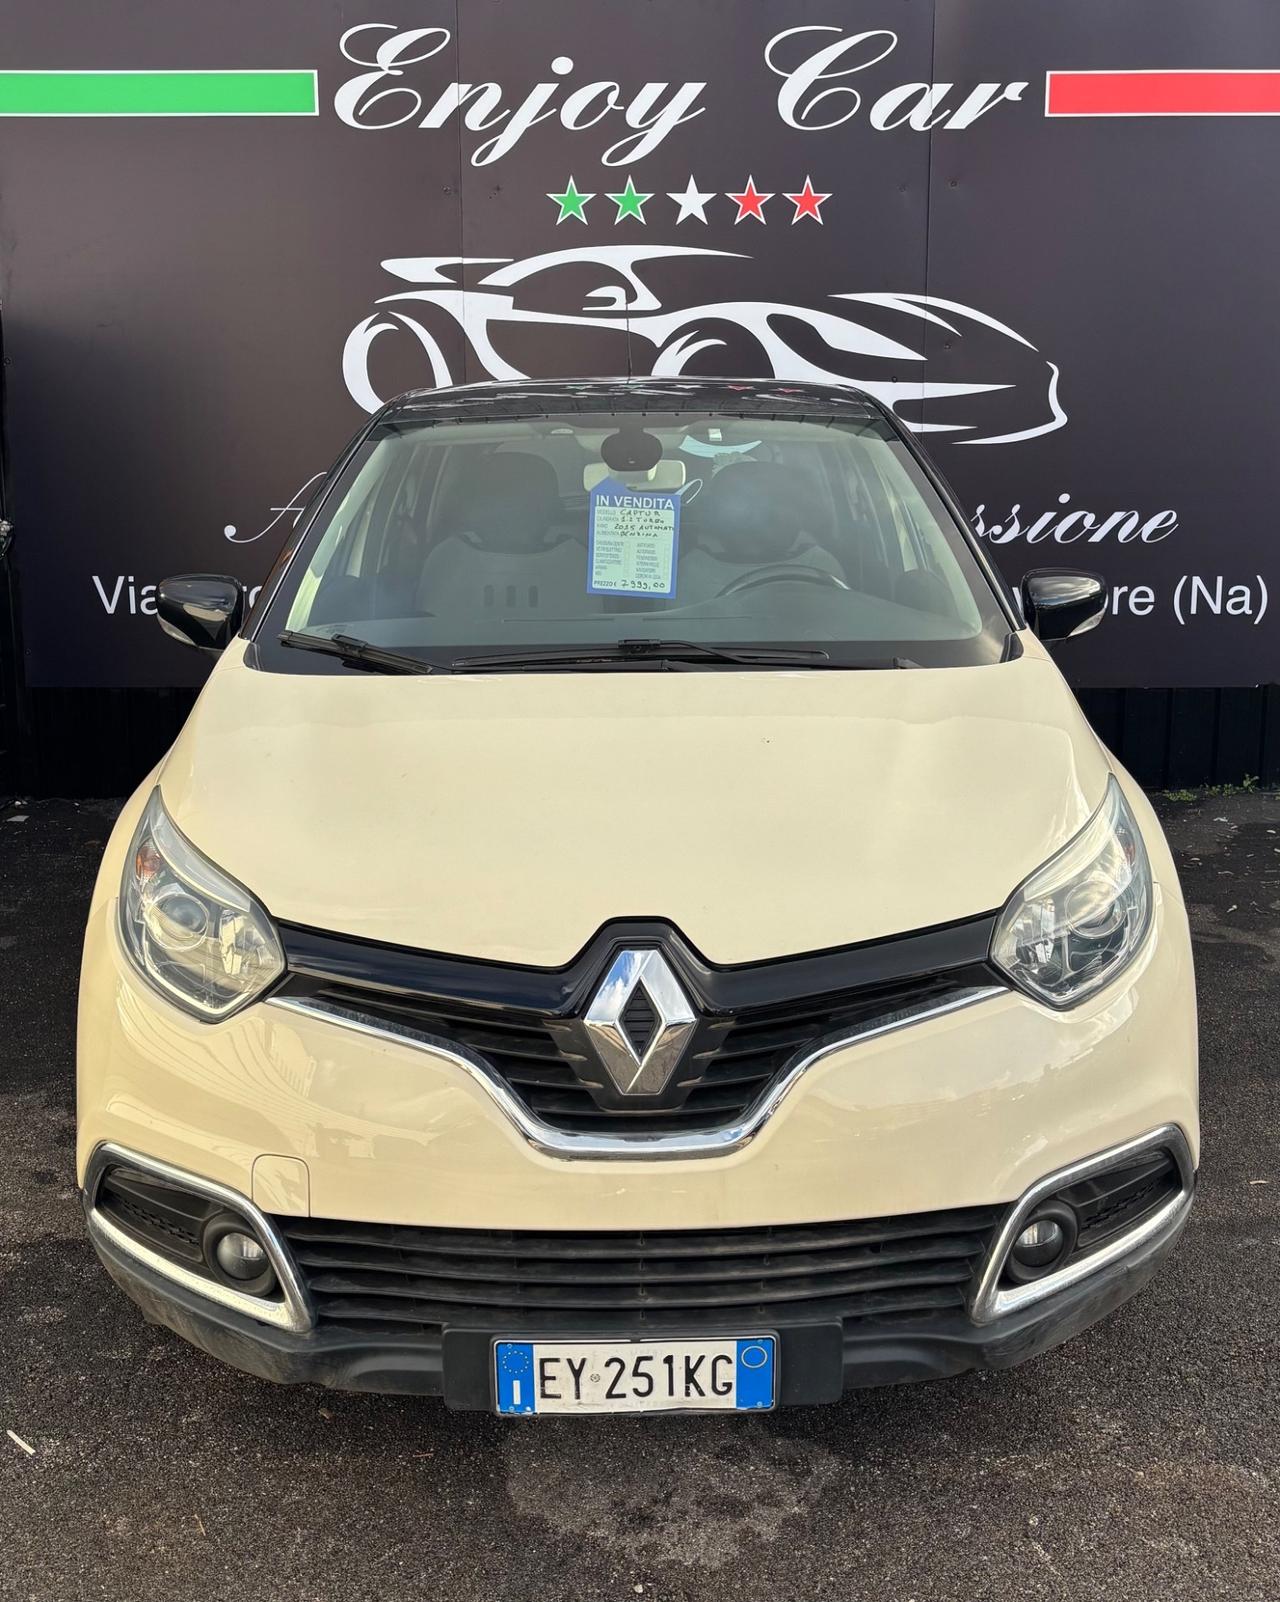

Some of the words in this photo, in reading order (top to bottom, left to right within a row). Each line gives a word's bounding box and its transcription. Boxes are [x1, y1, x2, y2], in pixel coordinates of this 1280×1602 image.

[334, 24, 707, 168] Enjoy
[765, 26, 1029, 132] Car
[596, 495, 609, 506] IN
[614, 496, 674, 509] VENDITA
[970, 493, 1179, 544] ssione
[1174, 575, 1268, 625] (Na)
